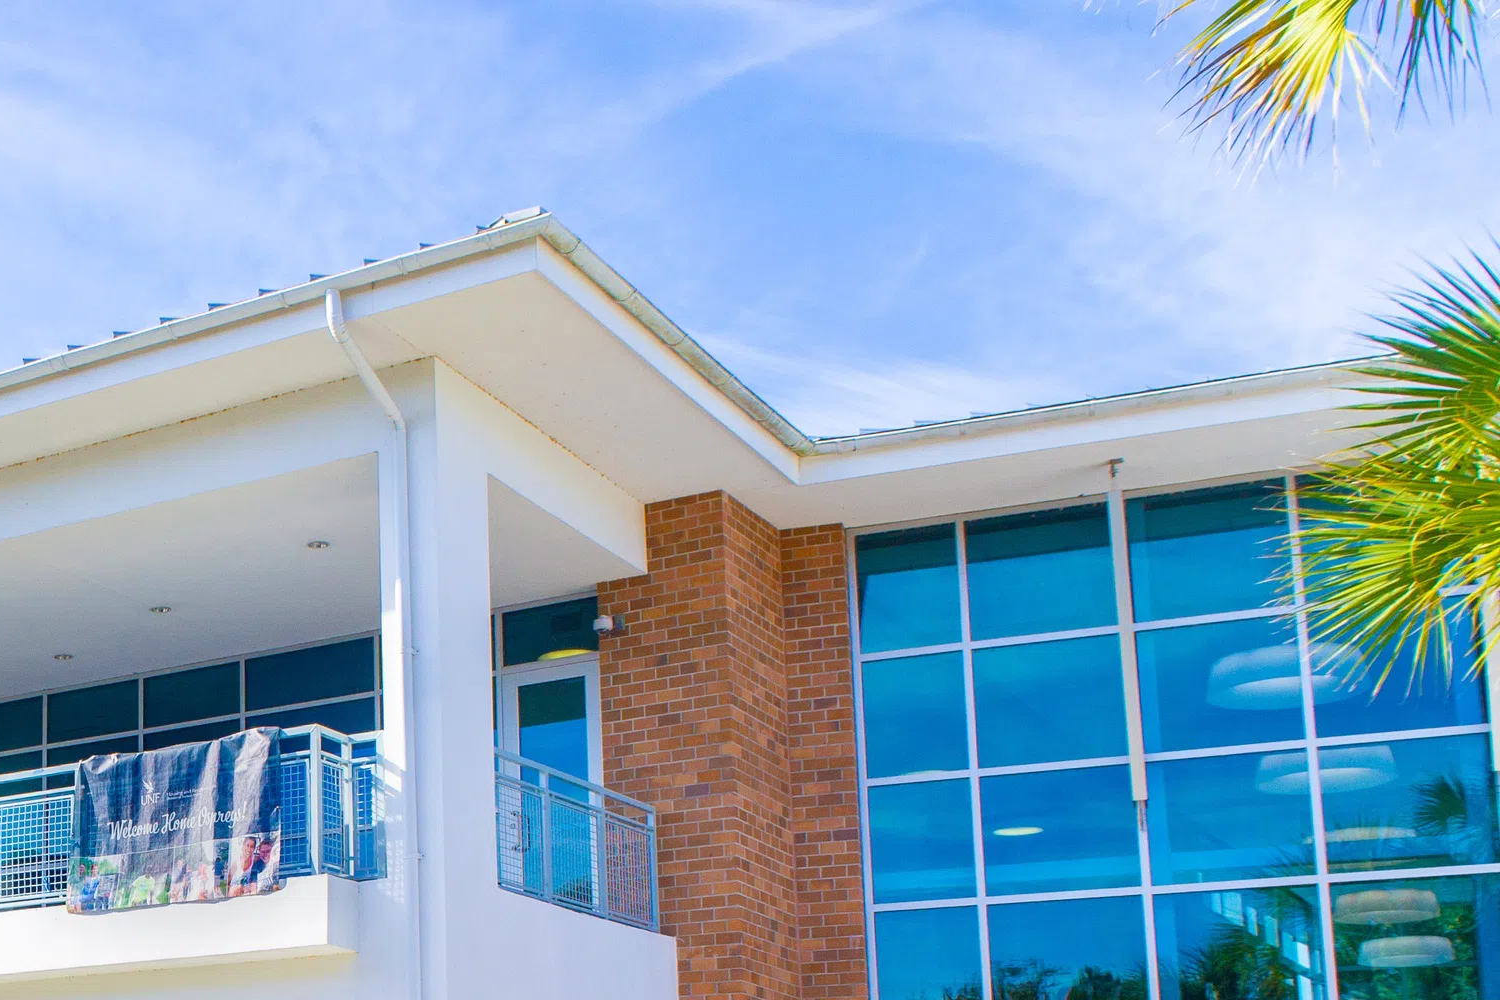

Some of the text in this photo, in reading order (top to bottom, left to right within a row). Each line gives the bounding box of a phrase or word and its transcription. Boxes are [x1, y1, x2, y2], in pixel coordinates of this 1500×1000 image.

[141, 792, 160, 806] UNF
[108, 801, 246, 840] Welcome Home Ospreys!
